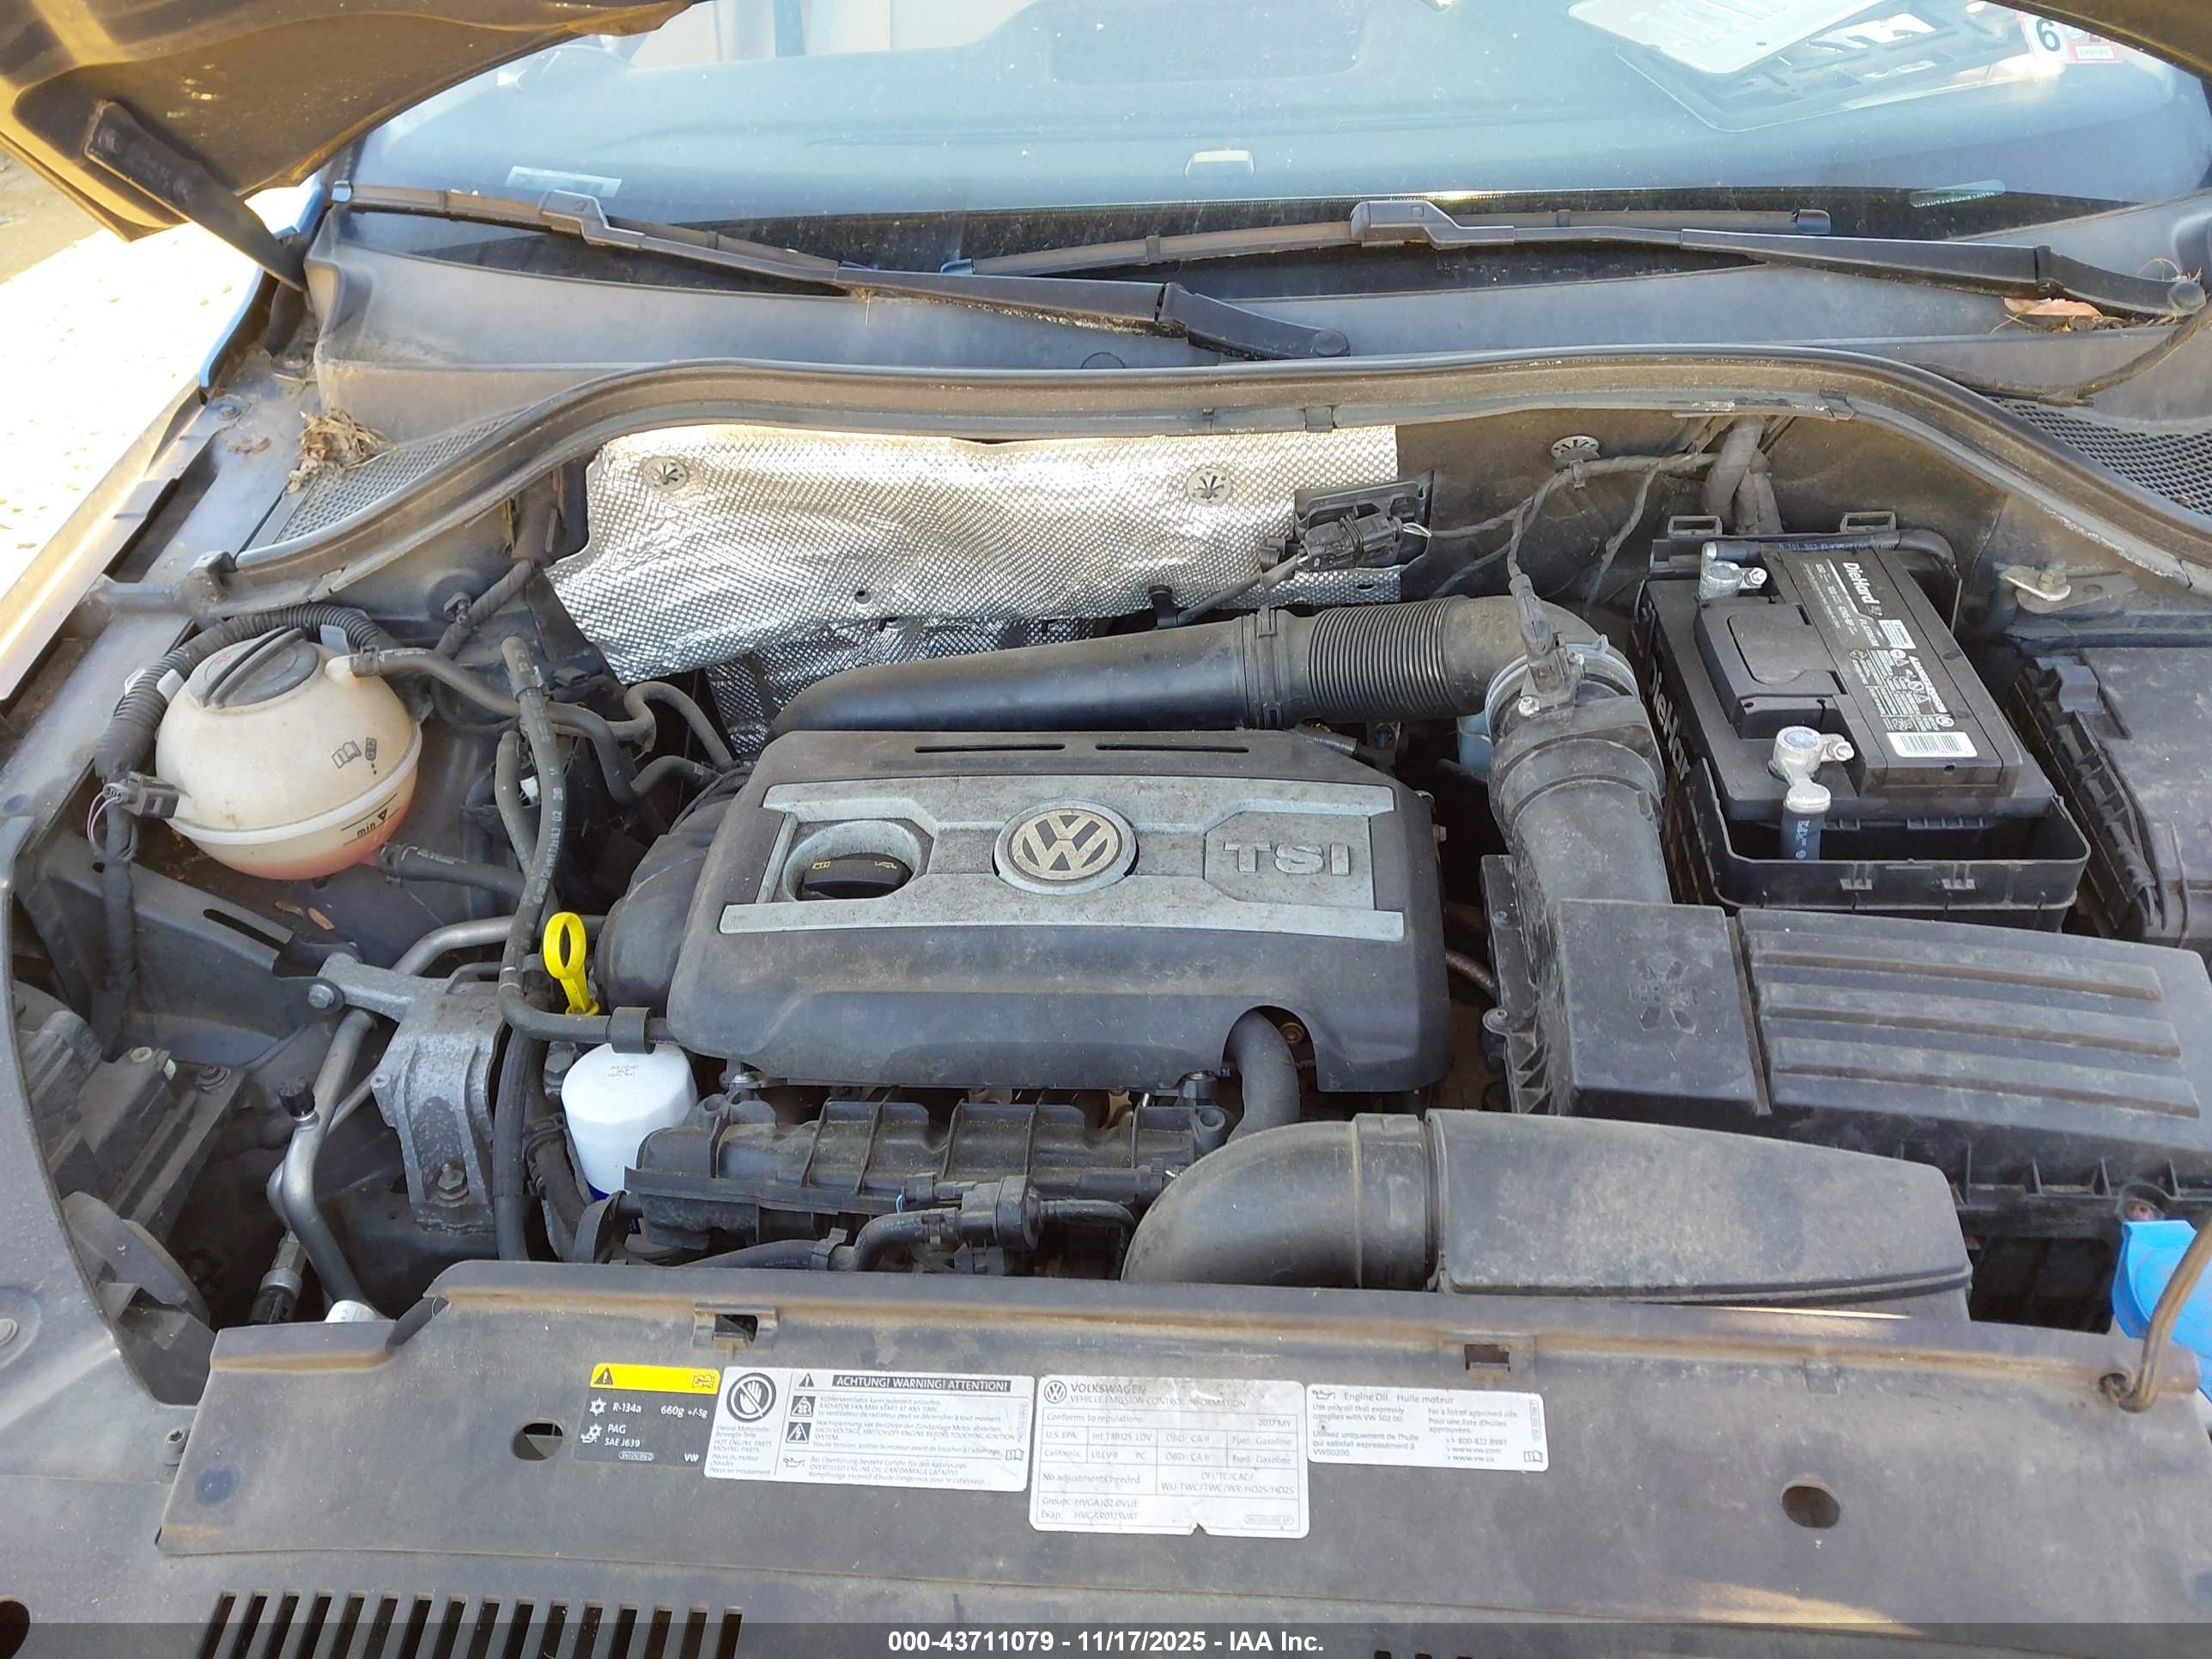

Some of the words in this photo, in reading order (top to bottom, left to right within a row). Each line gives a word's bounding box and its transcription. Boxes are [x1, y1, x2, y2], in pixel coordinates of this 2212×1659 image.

[2036, 18, 2061, 52] 6
[1841, 562, 1881, 605] DieHard
[356, 821, 378, 839] min
[1222, 841, 1350, 877] TSI
[836, 1376, 890, 1388] ACHTUNG!
[893, 1377, 945, 1389] WARNING!
[948, 1380, 1007, 1391] ATTENTION!
[1070, 1382, 1146, 1395] VOLKSWAGEN
[1105, 1396, 1145, 1406] EMISSION
[1146, 1397, 1183, 1406] CONTROL
[1188, 1398, 1247, 1408] INFORMATION
[1344, 1392, 1373, 1402] Engine
[1376, 1393, 1388, 1402] Oil
[1396, 1395, 1420, 1403] Huile
[1421, 1395, 1454, 1405] moteur
[612, 1401, 643, 1413] R-134a
[660, 1405, 685, 1419] 660g
[1371, 1407, 1405, 1415] expressly
[1468, 1410, 1502, 1419] approved
[1046, 1413, 1085, 1422] Conforms
[1462, 1418, 1477, 1426] liste
[607, 1423, 627, 1435] PAG
[1340, 1431, 1384, 1440] uniquement
[604, 1437, 620, 1447] SAE
[1255, 1437, 1291, 1445] Gasoline
[684, 1452, 700, 1462] VW
[1255, 1455, 1291, 1464] Gasoline
[1056, 1474, 1109, 1484] adjustments
